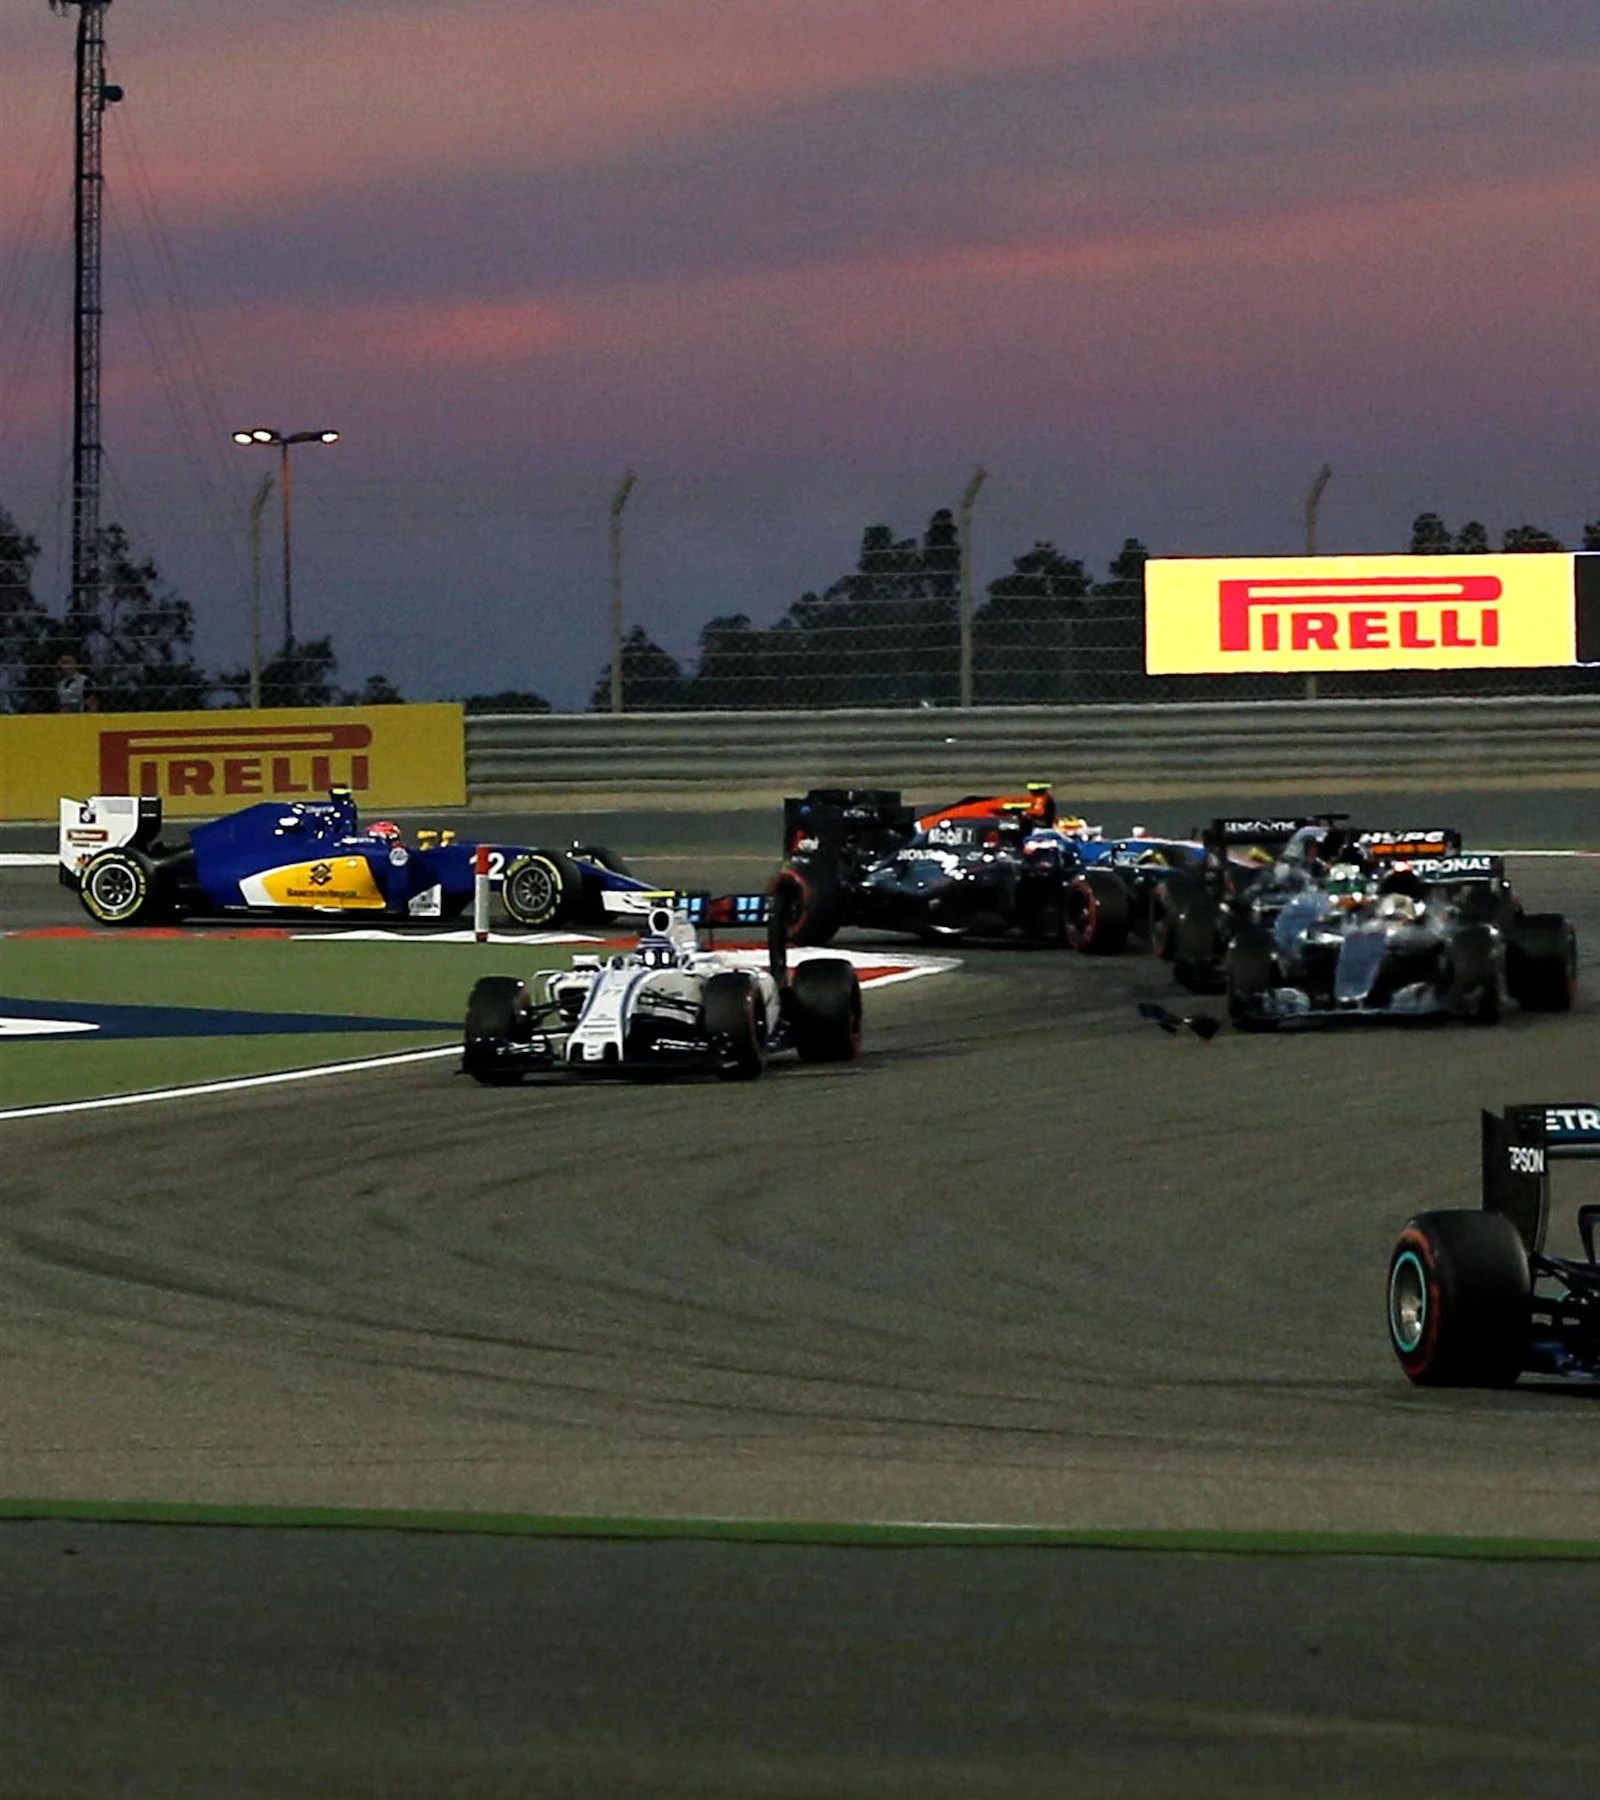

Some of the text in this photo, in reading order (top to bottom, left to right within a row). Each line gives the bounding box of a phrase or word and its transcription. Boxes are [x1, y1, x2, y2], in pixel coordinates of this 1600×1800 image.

[1219, 575, 1502, 651] PIRELLI
[99, 724, 373, 796] PIRELLI
[1413, 857, 1491, 873] TRONAS
